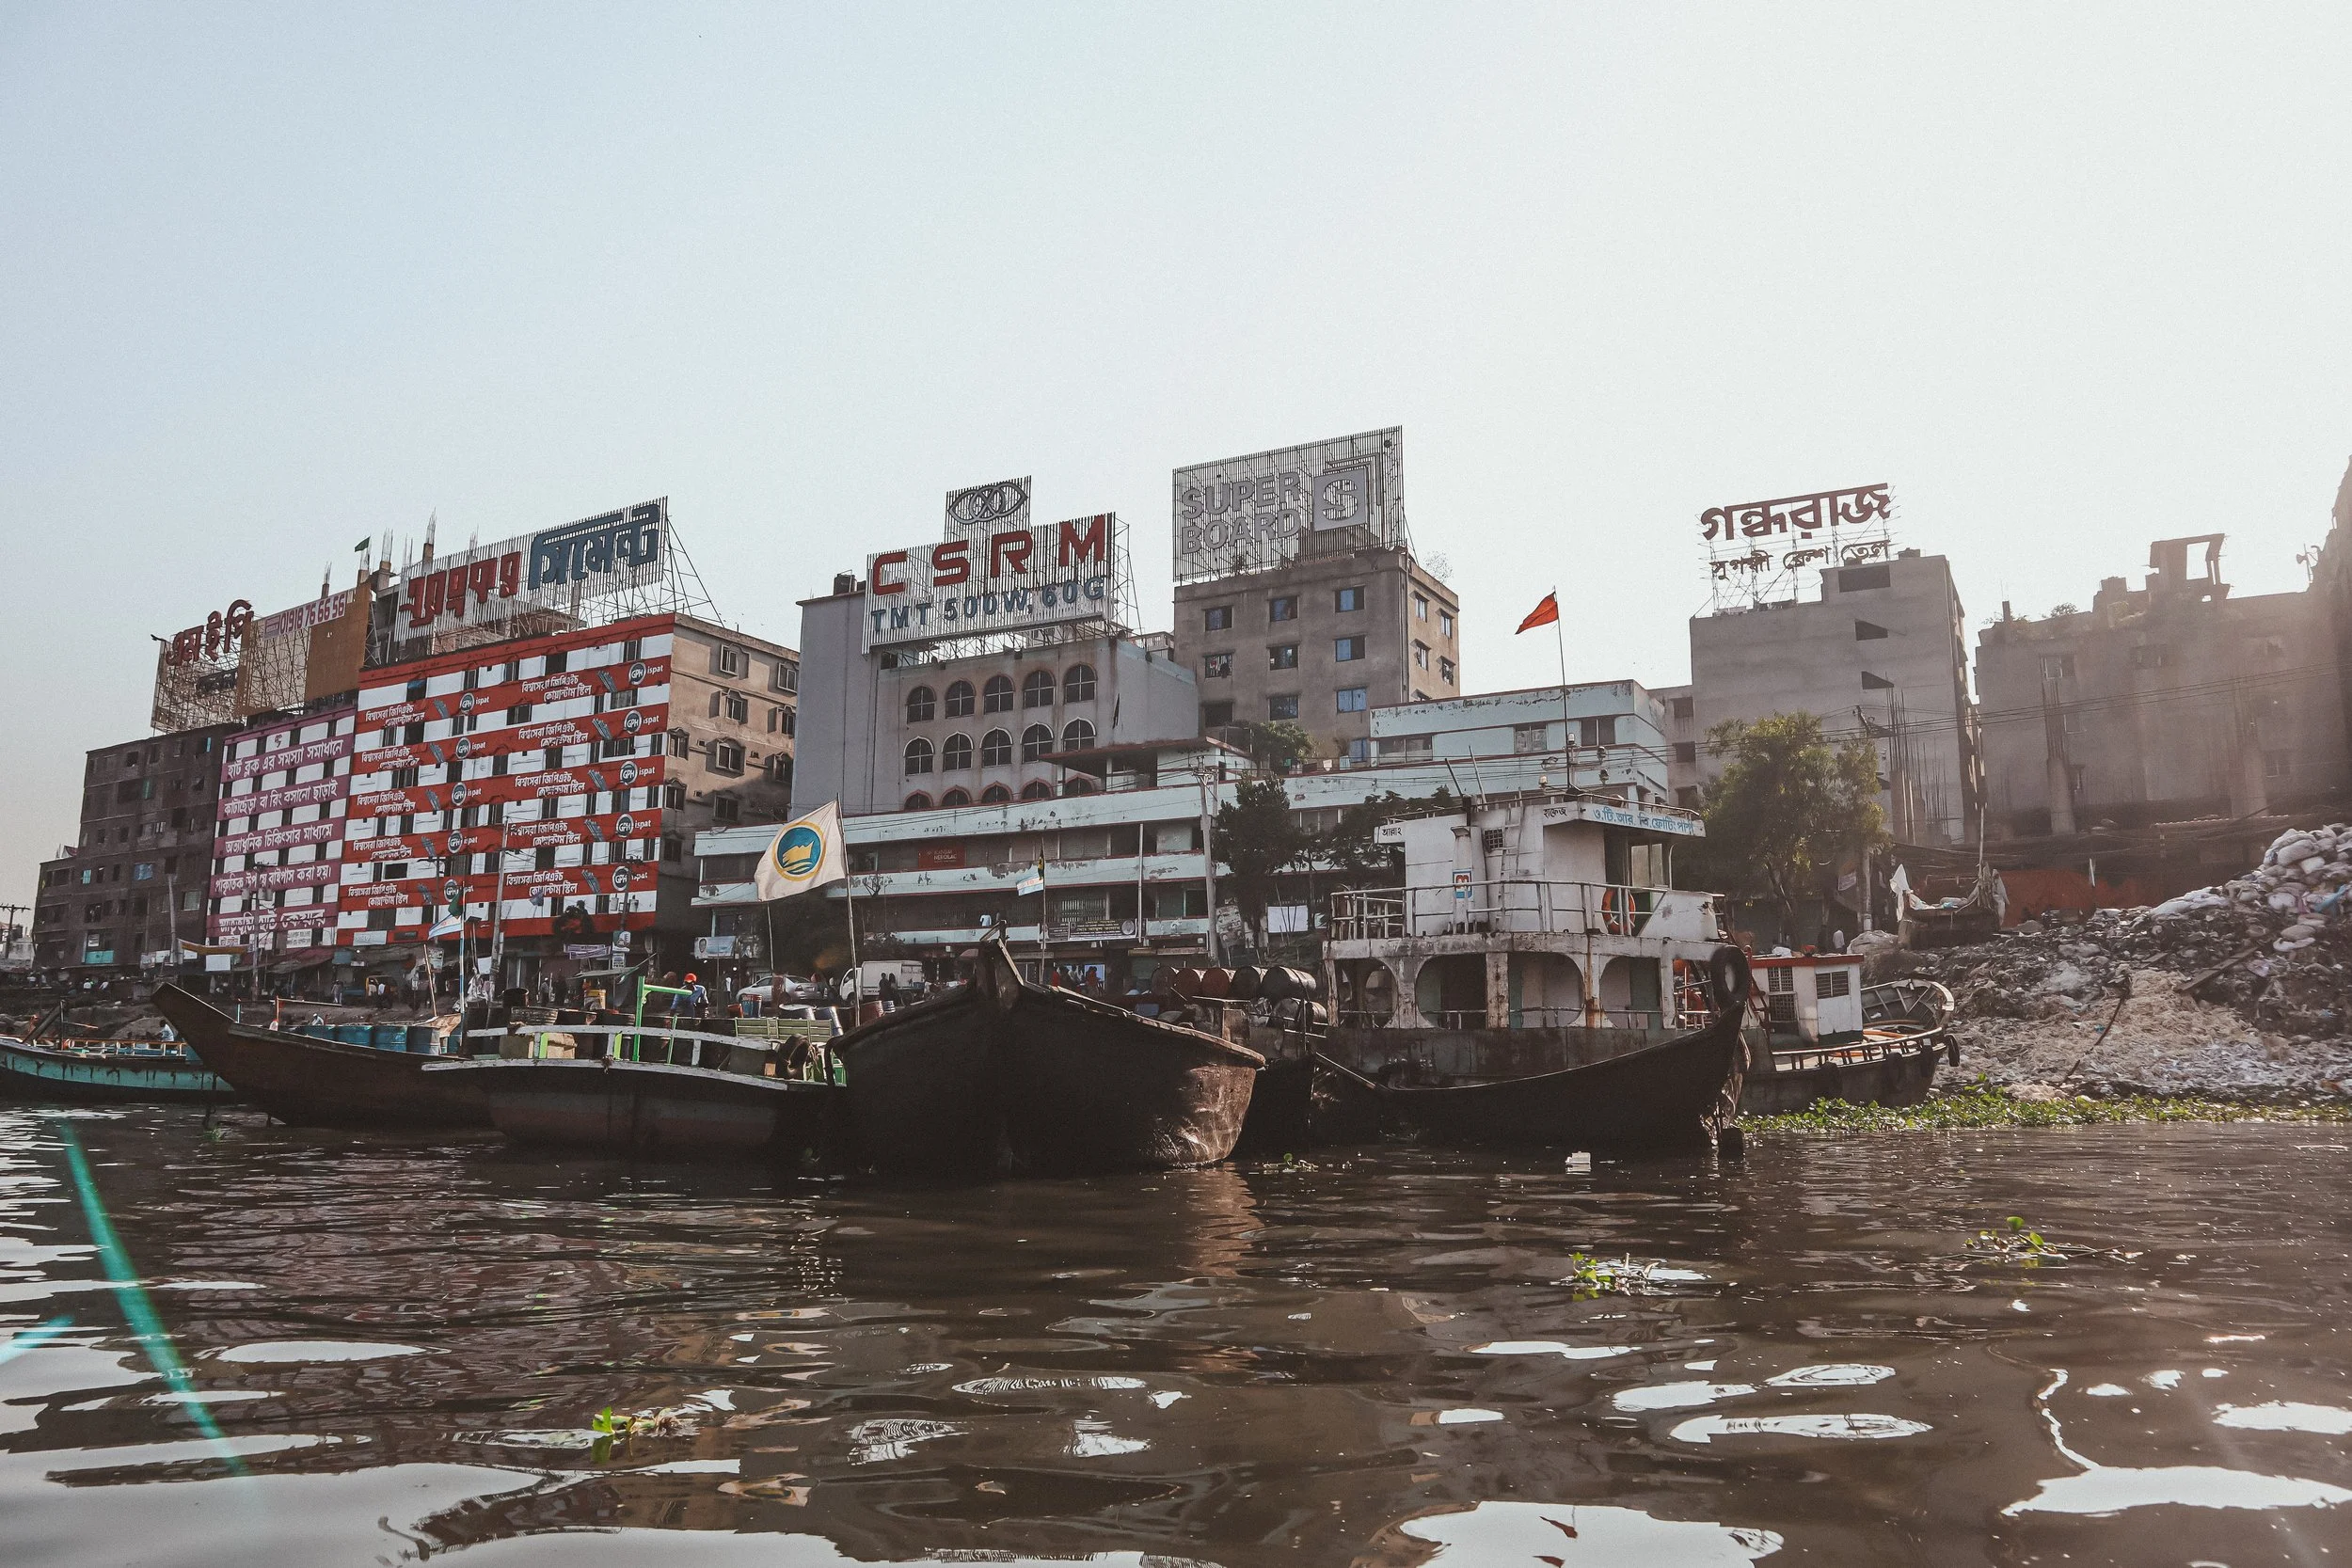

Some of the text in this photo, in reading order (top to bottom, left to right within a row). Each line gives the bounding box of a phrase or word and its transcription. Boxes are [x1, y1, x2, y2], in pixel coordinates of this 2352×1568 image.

[1183, 471, 1300, 519] SUPER
[1701, 483, 1891, 540] গন্ধরাজ
[1183, 509, 1301, 554] BOARD
[873, 514, 1105, 595] CSRM
[871, 602, 931, 632] TMT
[1043, 577, 1104, 607] 60G
[279, 607, 304, 634] 01918
[305, 602, 316, 626] 76
[318, 598, 330, 622] 66
[332, 594, 345, 618] 56
[630, 665, 663, 679] GPH ispat
[576, 682, 592, 697] স্টিল
[461, 696, 489, 708] GPH ispat
[627, 715, 659, 729] GPH ispat
[458, 742, 485, 753] GPH ispat
[228, 739, 343, 779] হার্ট ব্লক এর সমস্যা সমাধানে
[623, 767, 655, 780] GPH ispat
[260, 793, 268, 808] বা
[270, 790, 282, 807] রিং
[284, 786, 311, 802] বসানো
[311, 779, 338, 800] ছাড়াই
[453, 791, 465, 800] GPH
[618, 819, 651, 832] GPH ispat
[226, 832, 262, 854] অত্যাধুনিক
[304, 823, 333, 840] মাধ্যমে
[450, 838, 460, 847] GPH
[269, 867, 294, 885] বাইপাস
[297, 865, 314, 881] করা
[615, 874, 628, 884] GPH
[562, 879, 578, 895] স্টিল
[259, 908, 278, 931] হার্ট
[280, 909, 326, 928] কেয়ার
